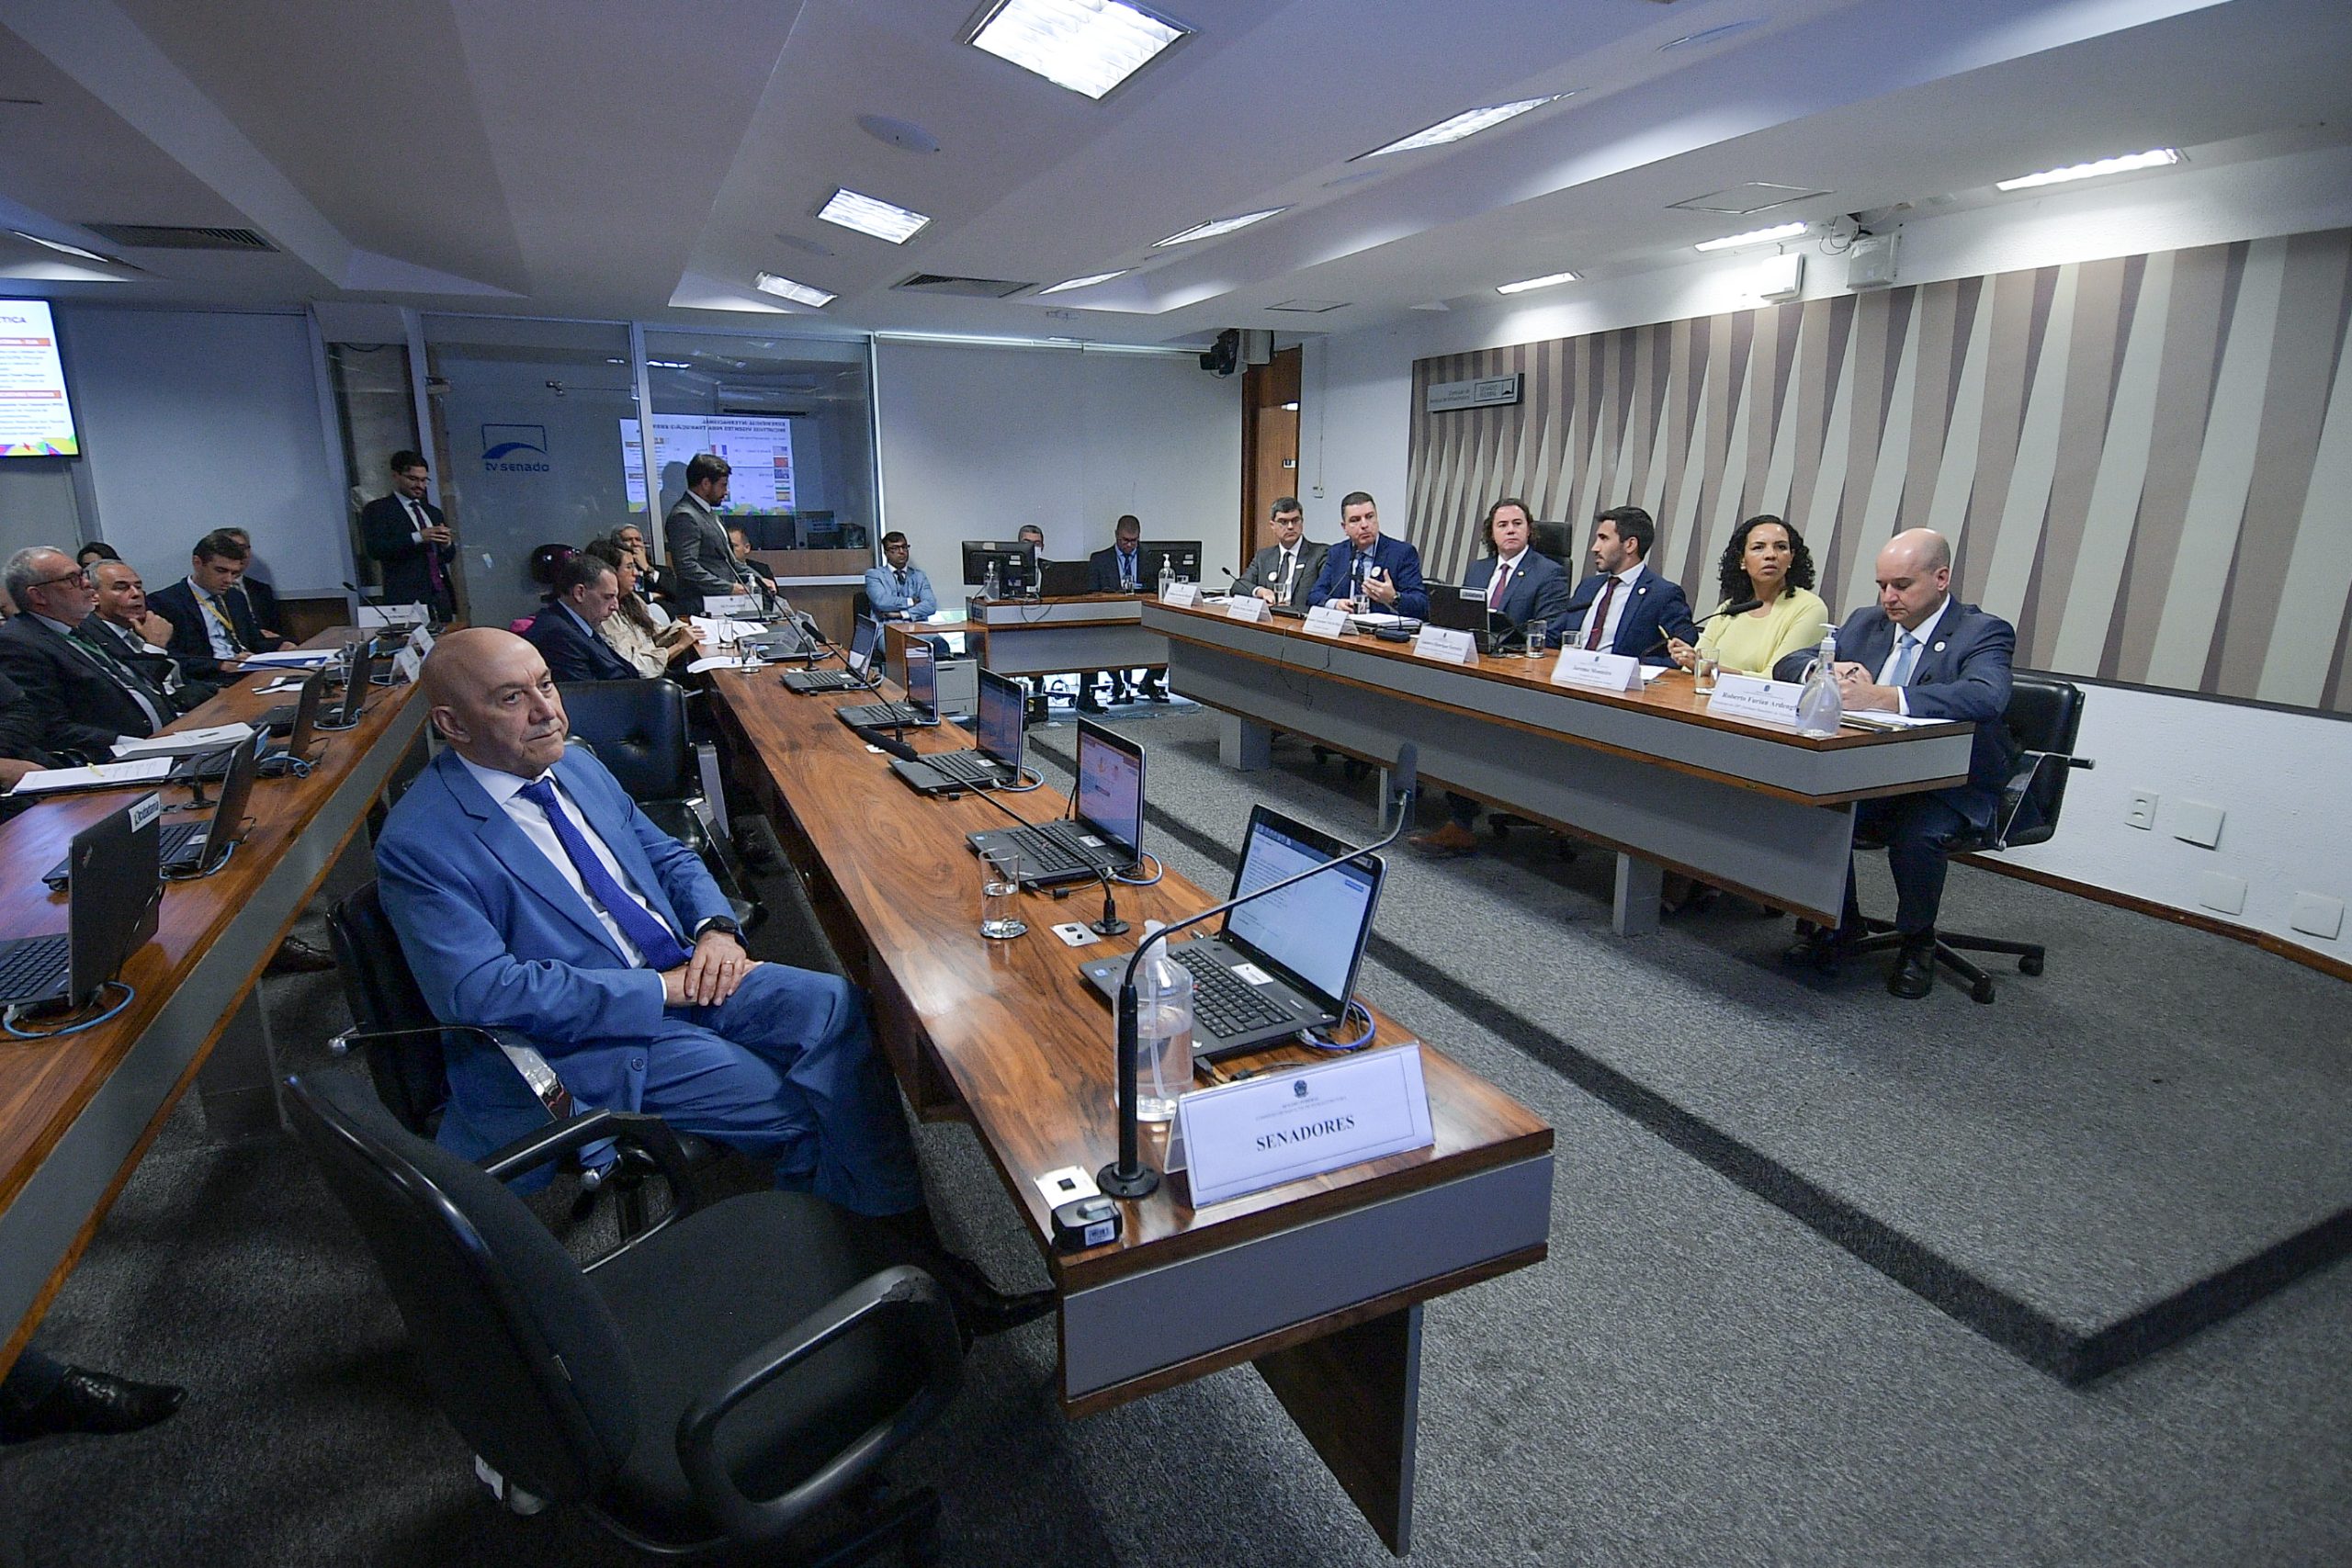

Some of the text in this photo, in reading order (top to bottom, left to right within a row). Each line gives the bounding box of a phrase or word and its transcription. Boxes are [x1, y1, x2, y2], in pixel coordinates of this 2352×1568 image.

[485, 461, 549, 472] tv senado
[1722, 692, 1747, 702] Roberto
[1256, 1114, 1355, 1152] SENADORES
